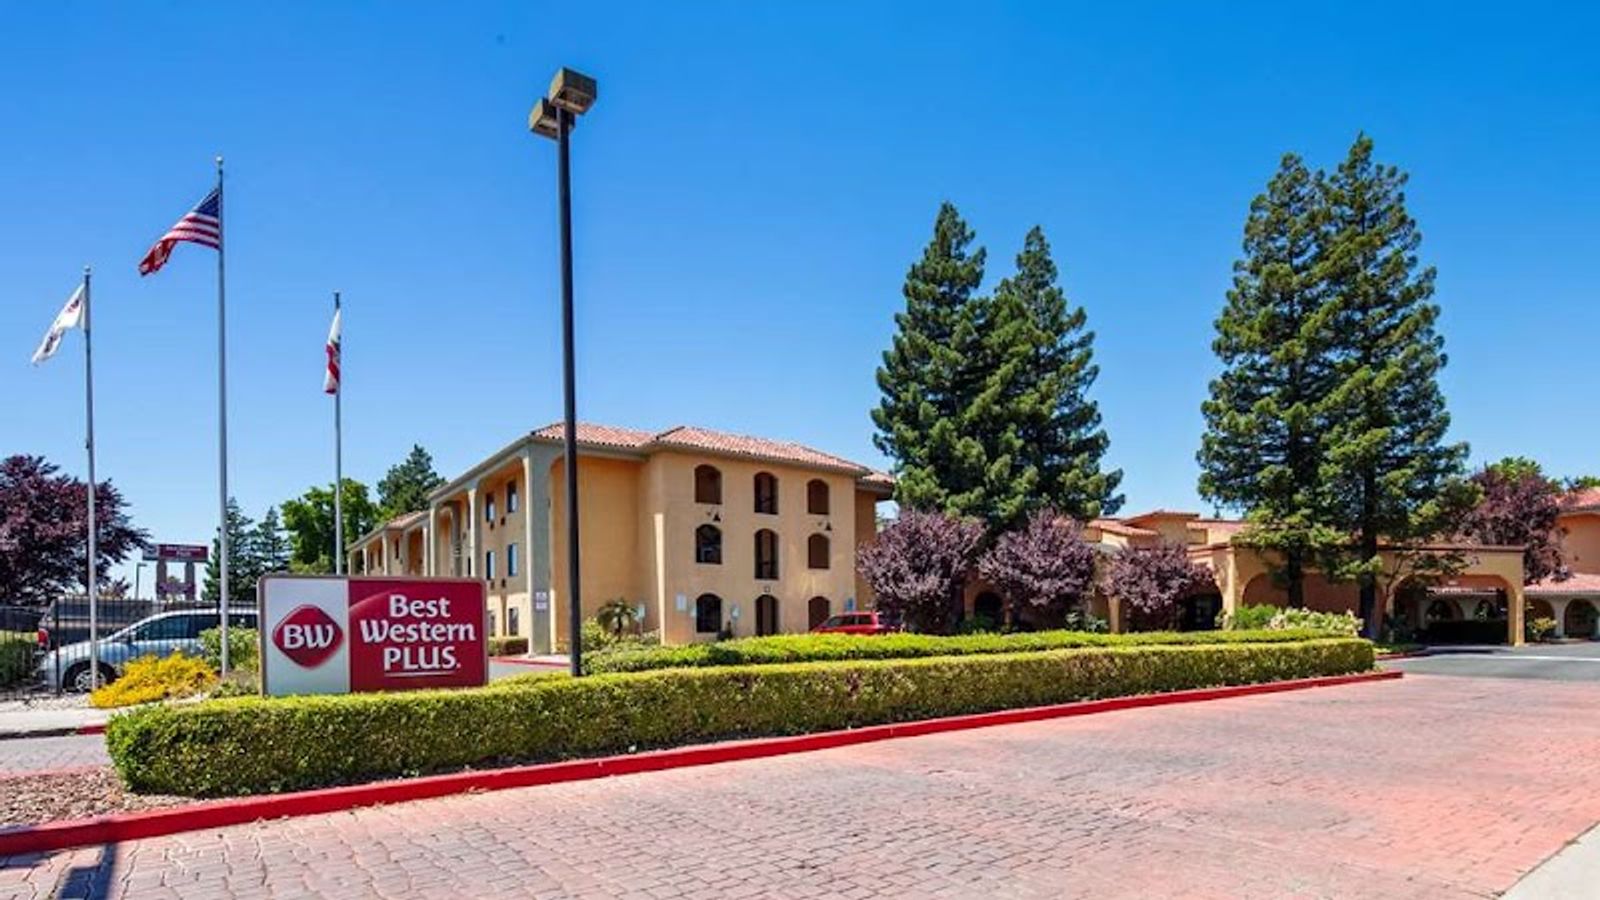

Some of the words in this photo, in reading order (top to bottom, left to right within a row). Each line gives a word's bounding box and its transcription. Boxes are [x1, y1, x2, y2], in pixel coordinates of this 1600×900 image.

[389, 594, 451, 618] Best
[283, 624, 334, 649] BW
[360, 619, 476, 643] Western
